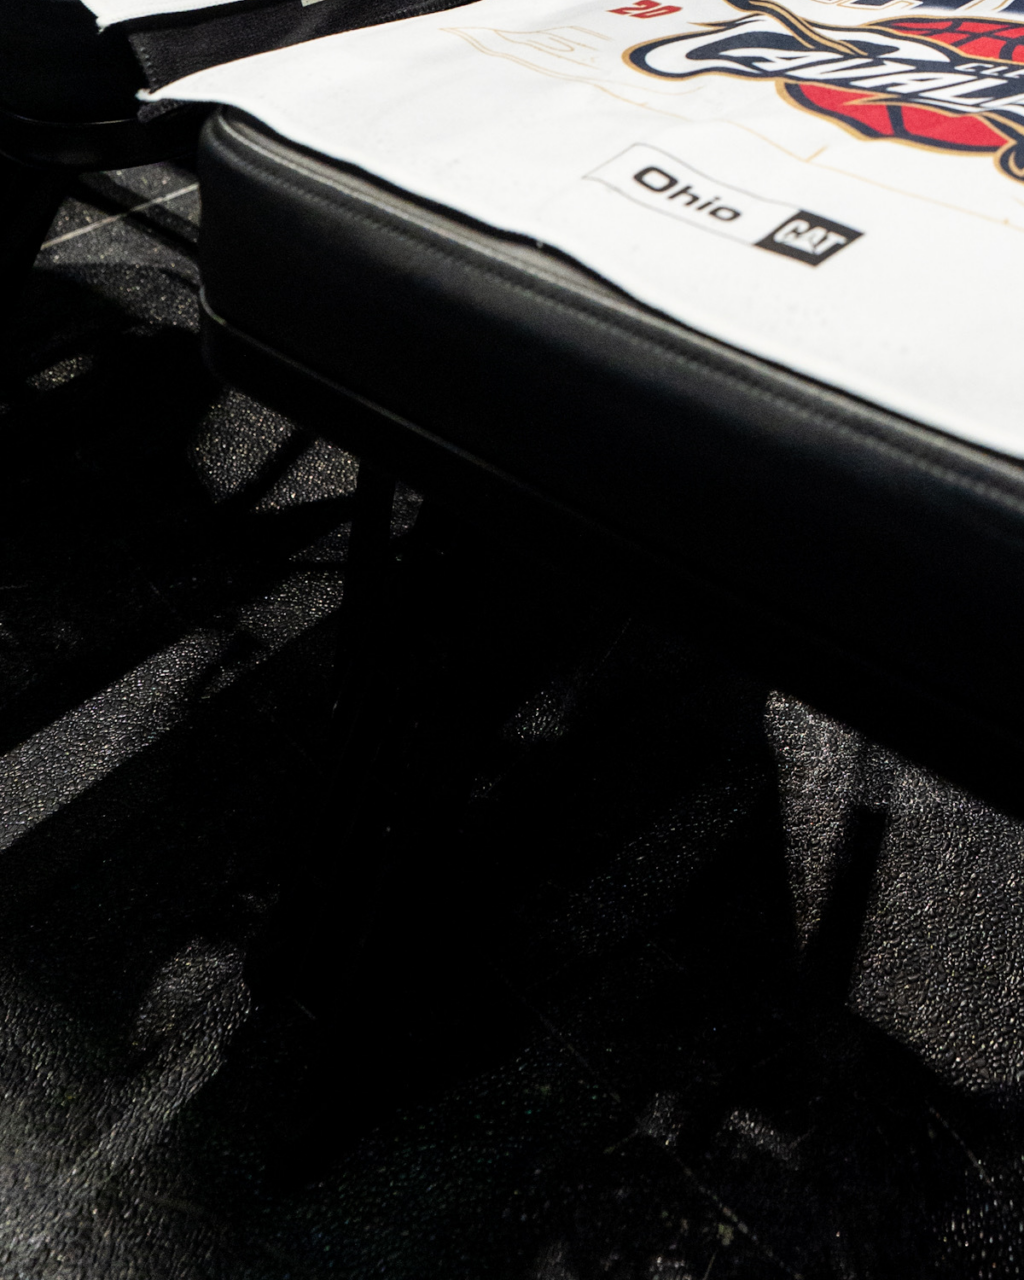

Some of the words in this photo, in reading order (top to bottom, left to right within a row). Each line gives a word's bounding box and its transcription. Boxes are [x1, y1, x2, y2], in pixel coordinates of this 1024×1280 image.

[607, 0, 682, 18] 20
[633, 166, 742, 222] Ohio
[773, 218, 848, 256] CAT
